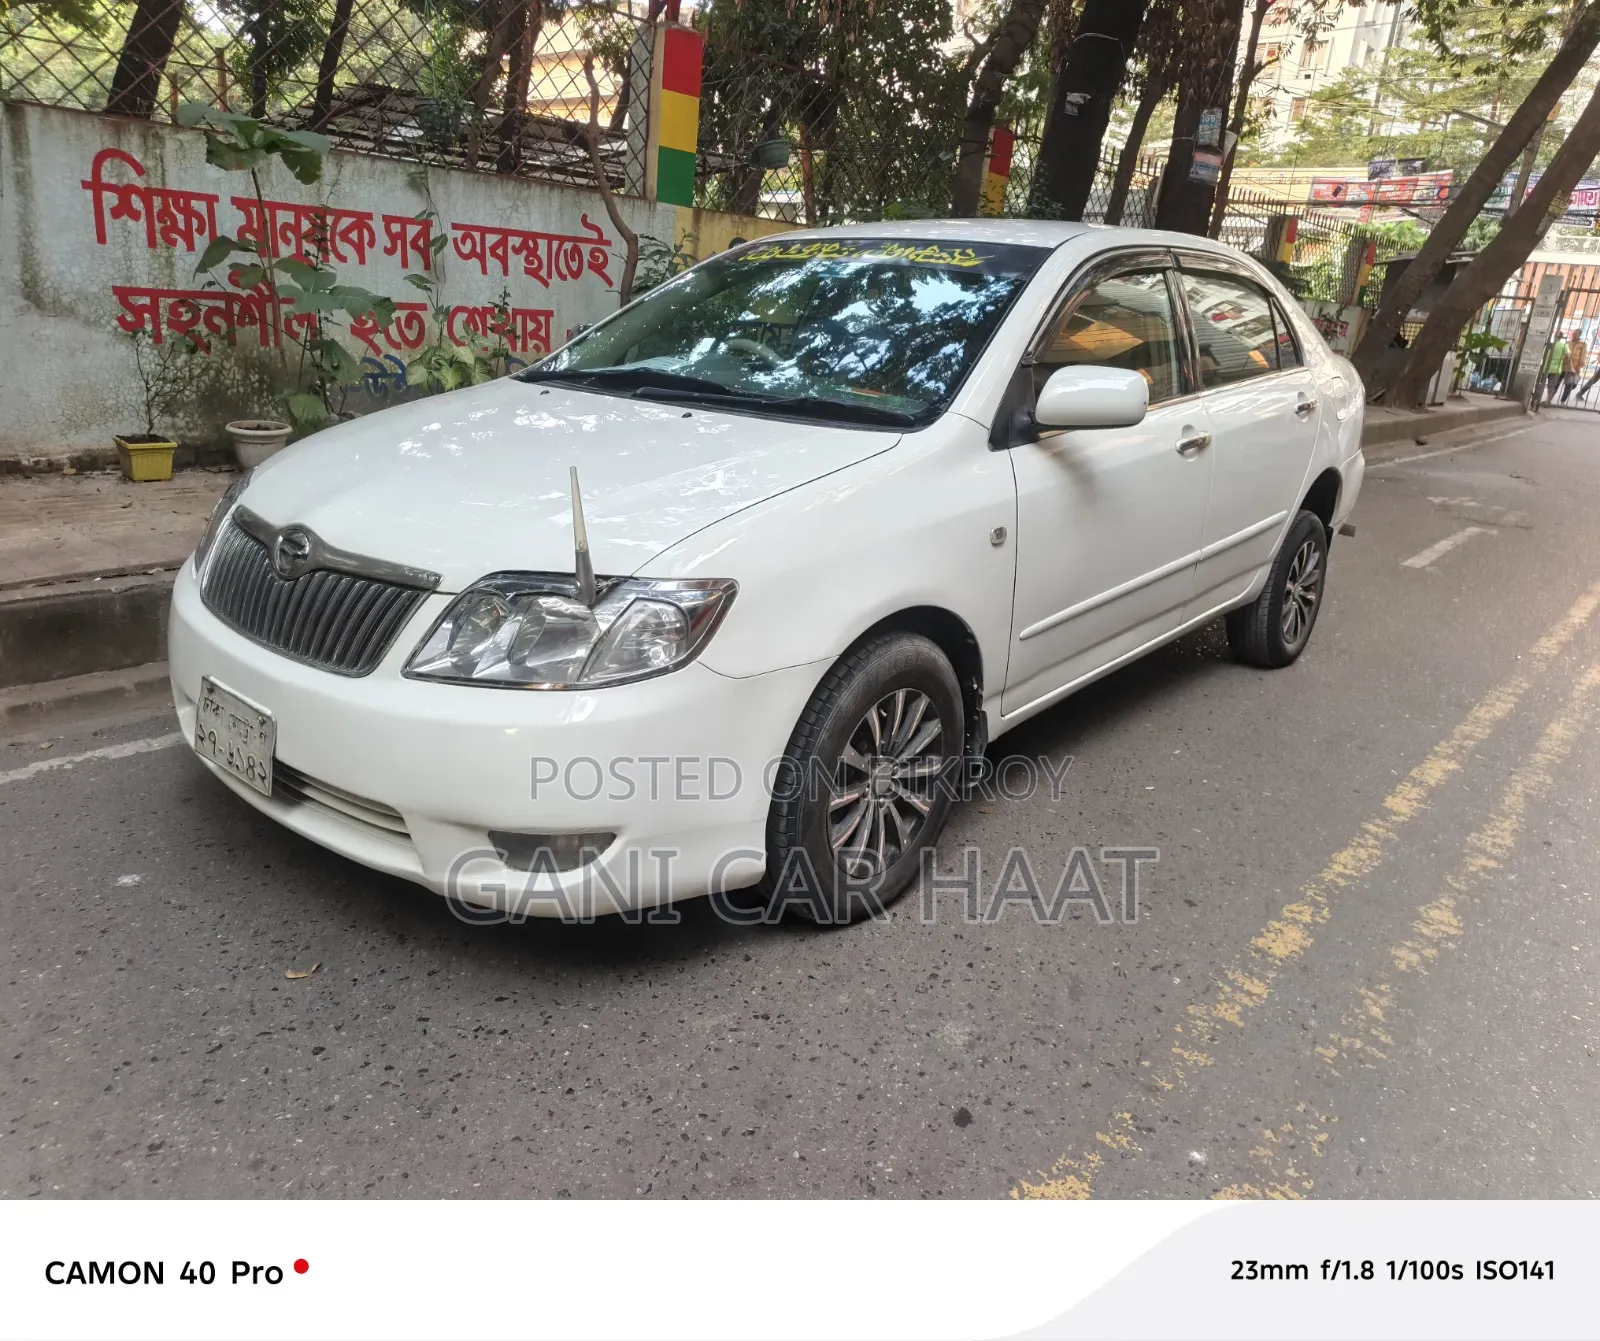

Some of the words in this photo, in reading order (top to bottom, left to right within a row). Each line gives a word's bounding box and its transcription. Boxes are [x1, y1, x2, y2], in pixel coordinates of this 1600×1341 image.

[81, 148, 219, 252] শিক্ষা
[231, 196, 375, 268] মানুষকে
[382, 214, 433, 271] সব
[451, 213, 614, 288] অবস্থাতেই
